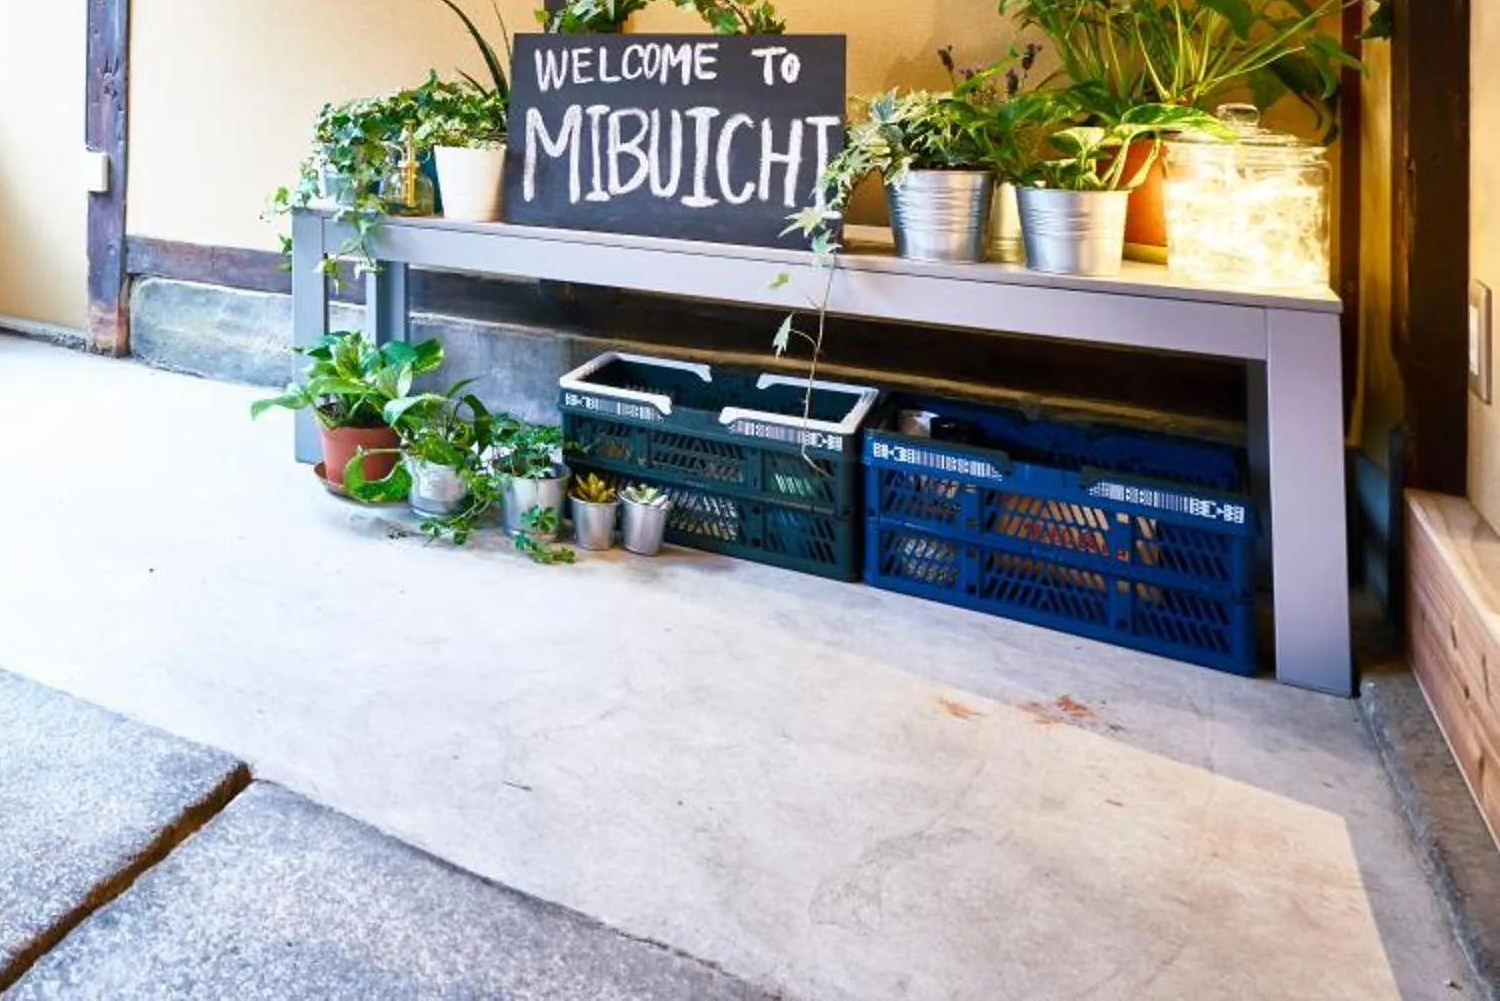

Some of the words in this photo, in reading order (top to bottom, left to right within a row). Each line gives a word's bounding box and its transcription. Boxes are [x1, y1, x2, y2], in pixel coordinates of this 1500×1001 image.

[534, 42, 719, 93] WELCOME
[750, 46, 801, 86] TO
[523, 104, 842, 219] MIBUICHI
